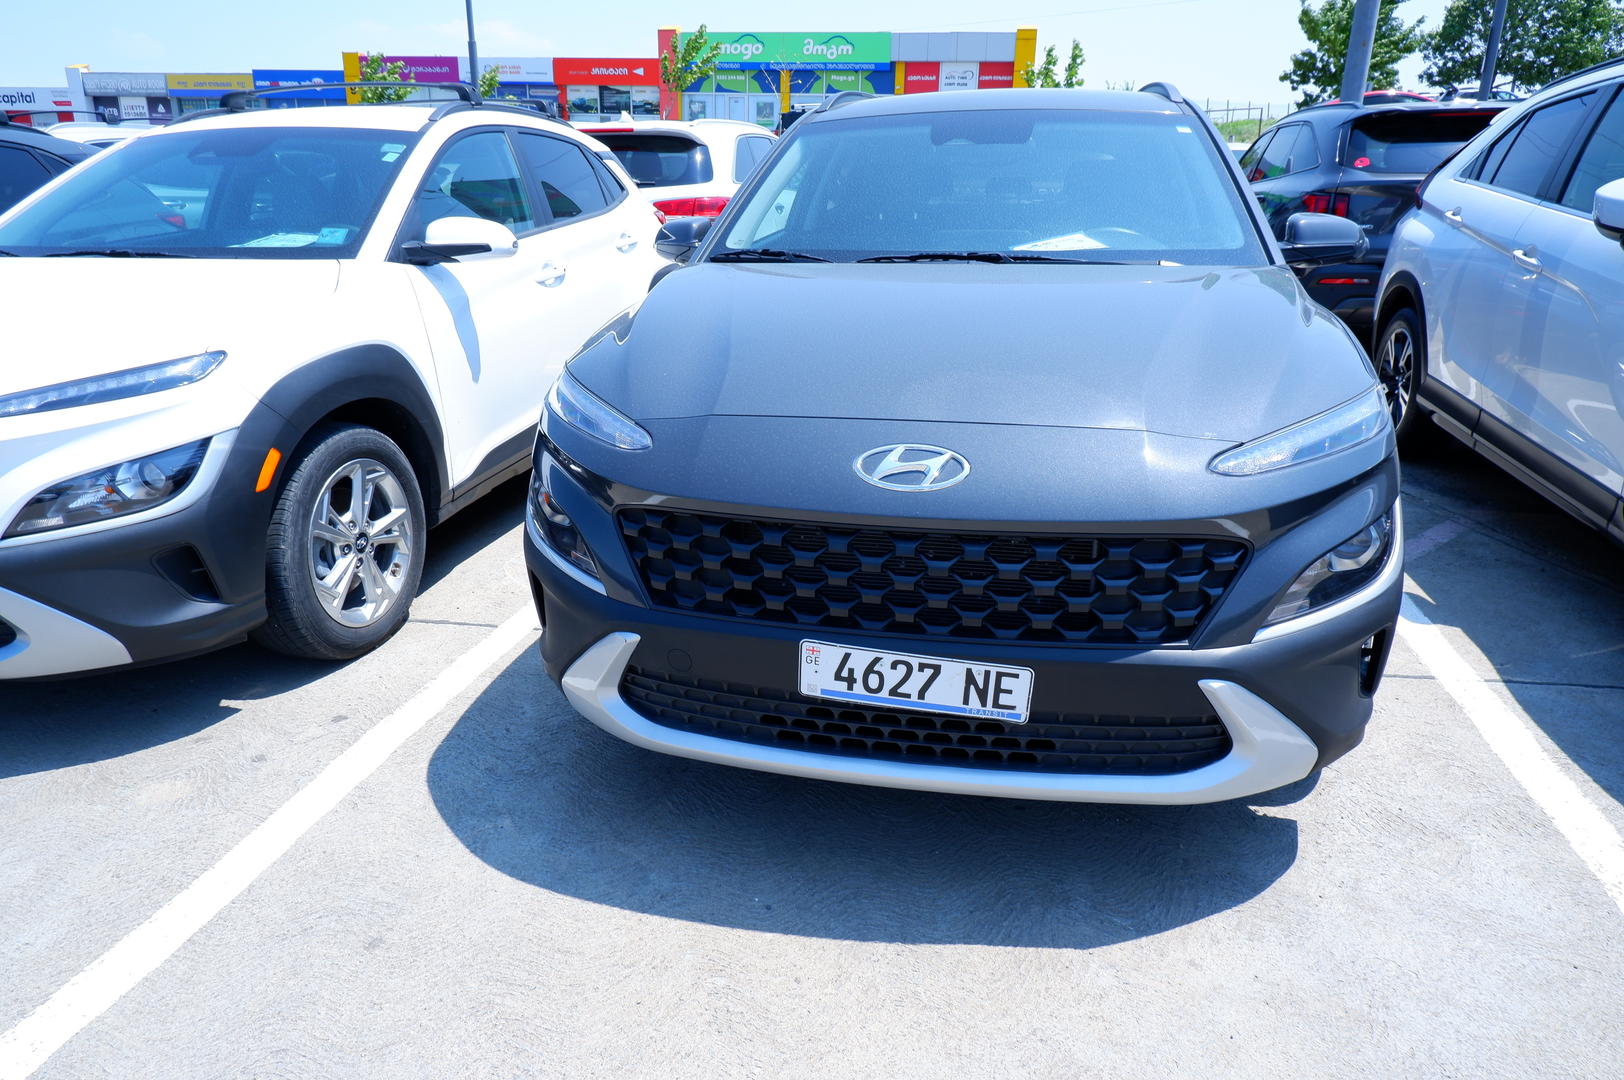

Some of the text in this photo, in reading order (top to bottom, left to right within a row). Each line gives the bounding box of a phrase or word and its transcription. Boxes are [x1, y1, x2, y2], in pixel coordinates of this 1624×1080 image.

[0, 91, 36, 106] apital
[806, 656, 820, 666] GE
[834, 652, 1020, 711] 4627 NE
[966, 708, 1009, 718] TRANSIT
